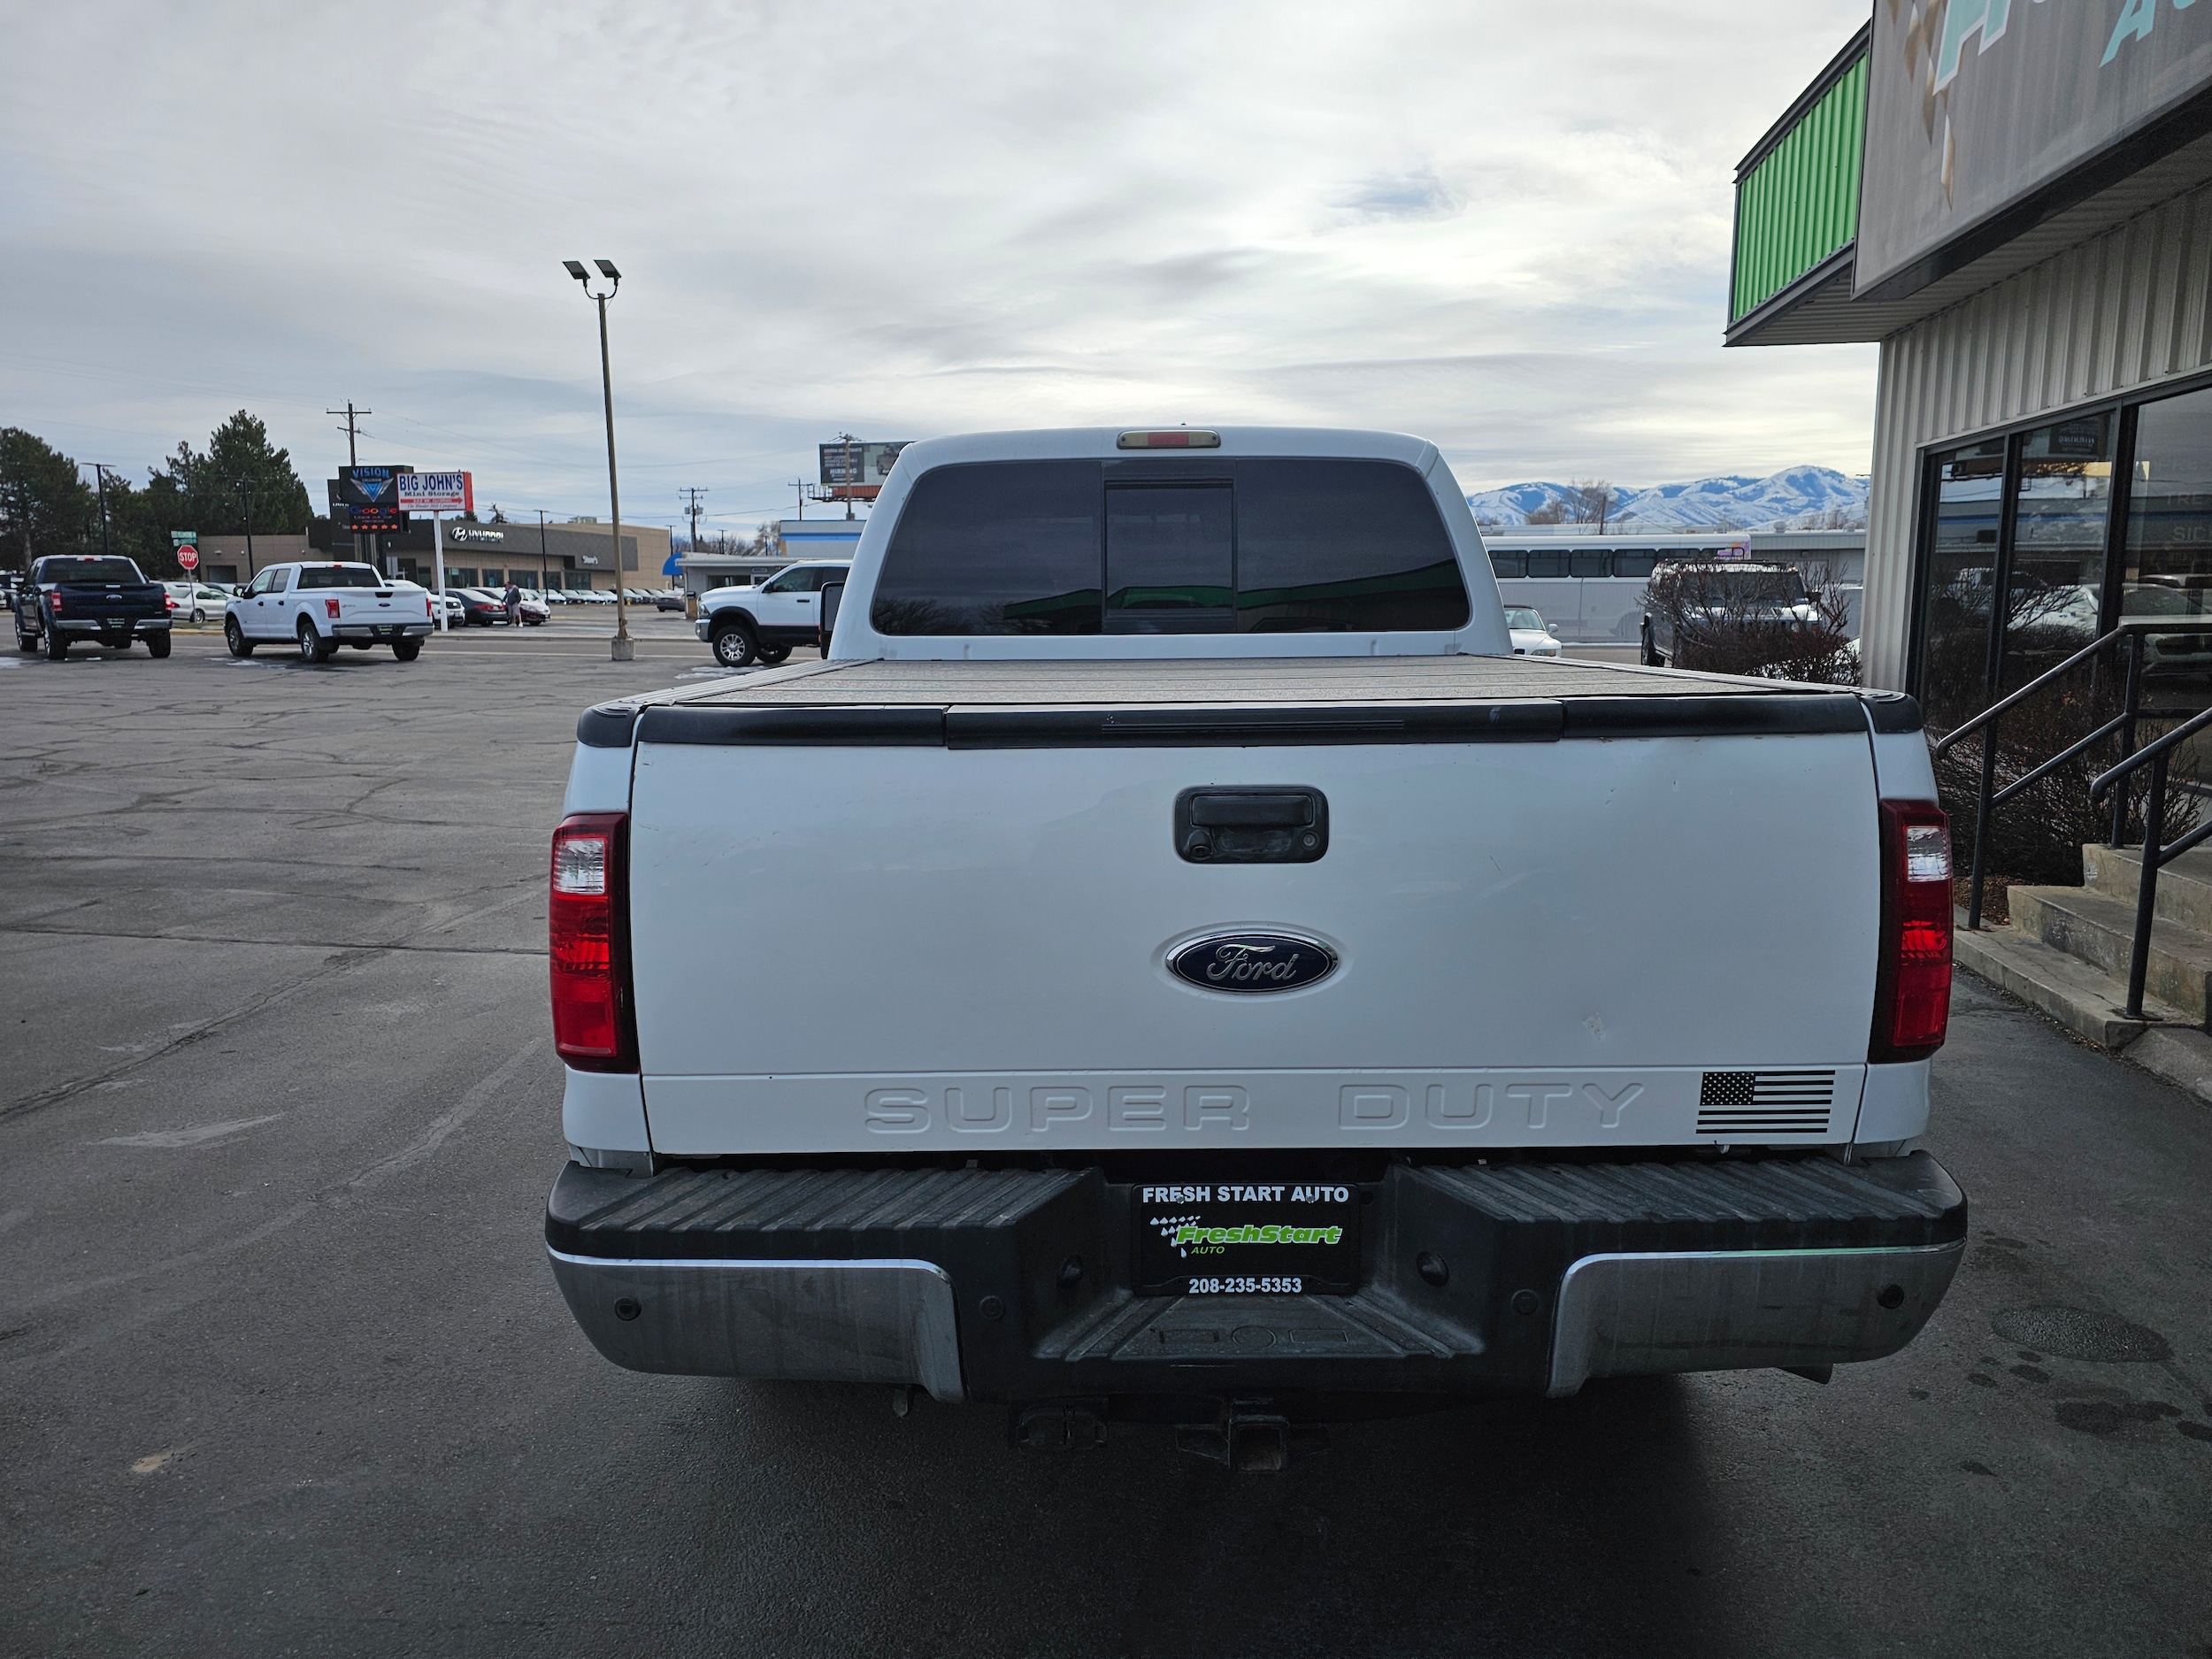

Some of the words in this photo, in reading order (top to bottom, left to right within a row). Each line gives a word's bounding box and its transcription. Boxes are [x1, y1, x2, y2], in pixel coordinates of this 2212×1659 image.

[352, 467, 390, 478] VISION
[399, 475, 419, 491] BIG
[422, 474, 463, 490] JOHN'S
[349, 506, 397, 517] Google
[180, 552, 196, 562] STOP
[1206, 943, 1300, 981] Ford
[864, 1085, 1250, 1133] SUPER
[1338, 1083, 1645, 1131] DUTY
[1142, 1187, 1210, 1202] FRESH
[1217, 1187, 1285, 1202] START
[1291, 1187, 1349, 1202] AUTO
[1176, 1225, 1342, 1244] FreshStart
[1191, 1246, 1225, 1255] AUTO
[1188, 1278, 1302, 1294] 208-235-5353
